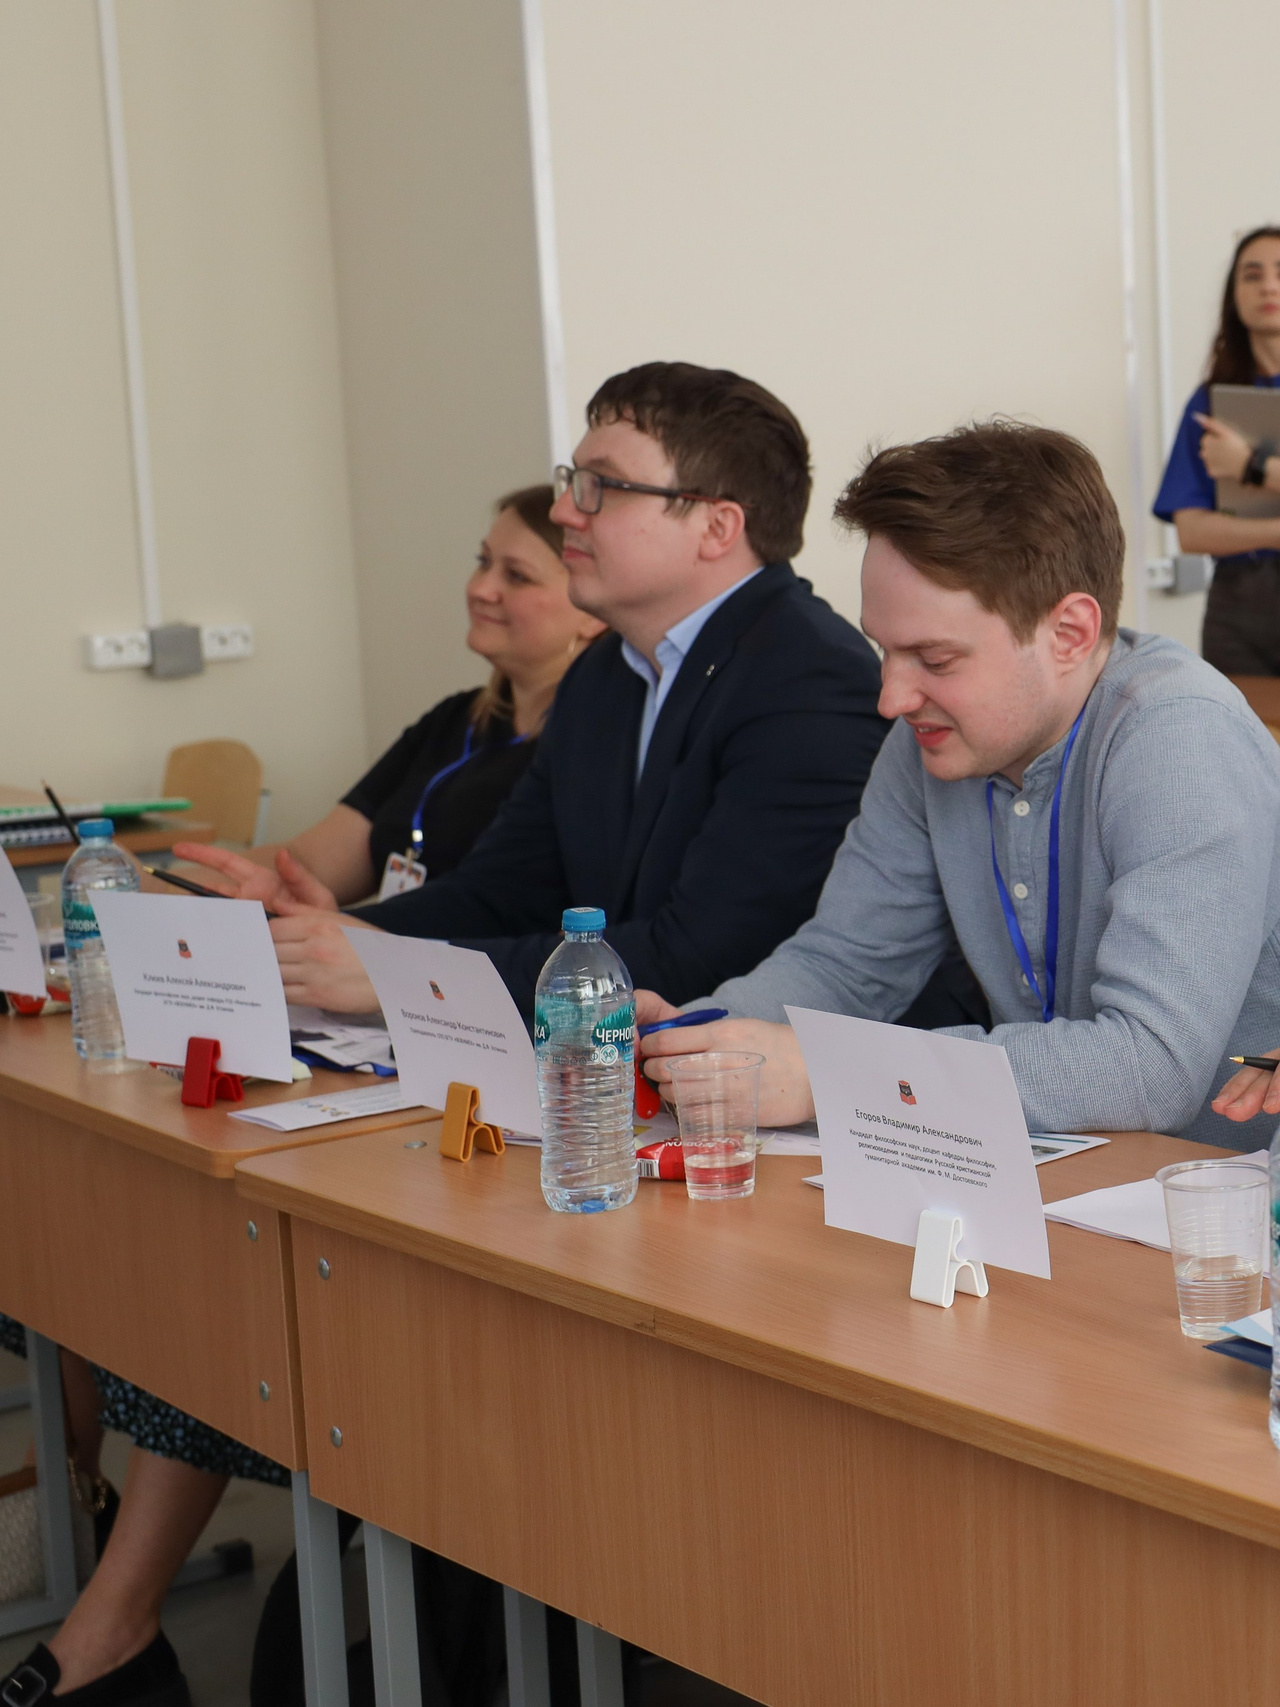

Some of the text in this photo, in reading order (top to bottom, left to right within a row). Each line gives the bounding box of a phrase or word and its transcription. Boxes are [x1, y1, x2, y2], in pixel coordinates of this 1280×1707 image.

[849, 1128, 873, 1140] Кандидат
[874, 1134, 907, 1148] философских
[922, 1146, 941, 1156] доцент
[941, 1151, 965, 1162] кафедры
[855, 1108, 983, 1147] Егоров Владимир Александрович
[858, 1141, 899, 1156] религиоведения
[905, 1152, 934, 1164] педагогики
[934, 1158, 956, 1170] Русской
[956, 1165, 992, 1179] христианской
[864, 1153, 900, 1166] гуманитарной
[901, 1162, 927, 1173] академии
[952, 1173, 988, 1188] Достоевского
